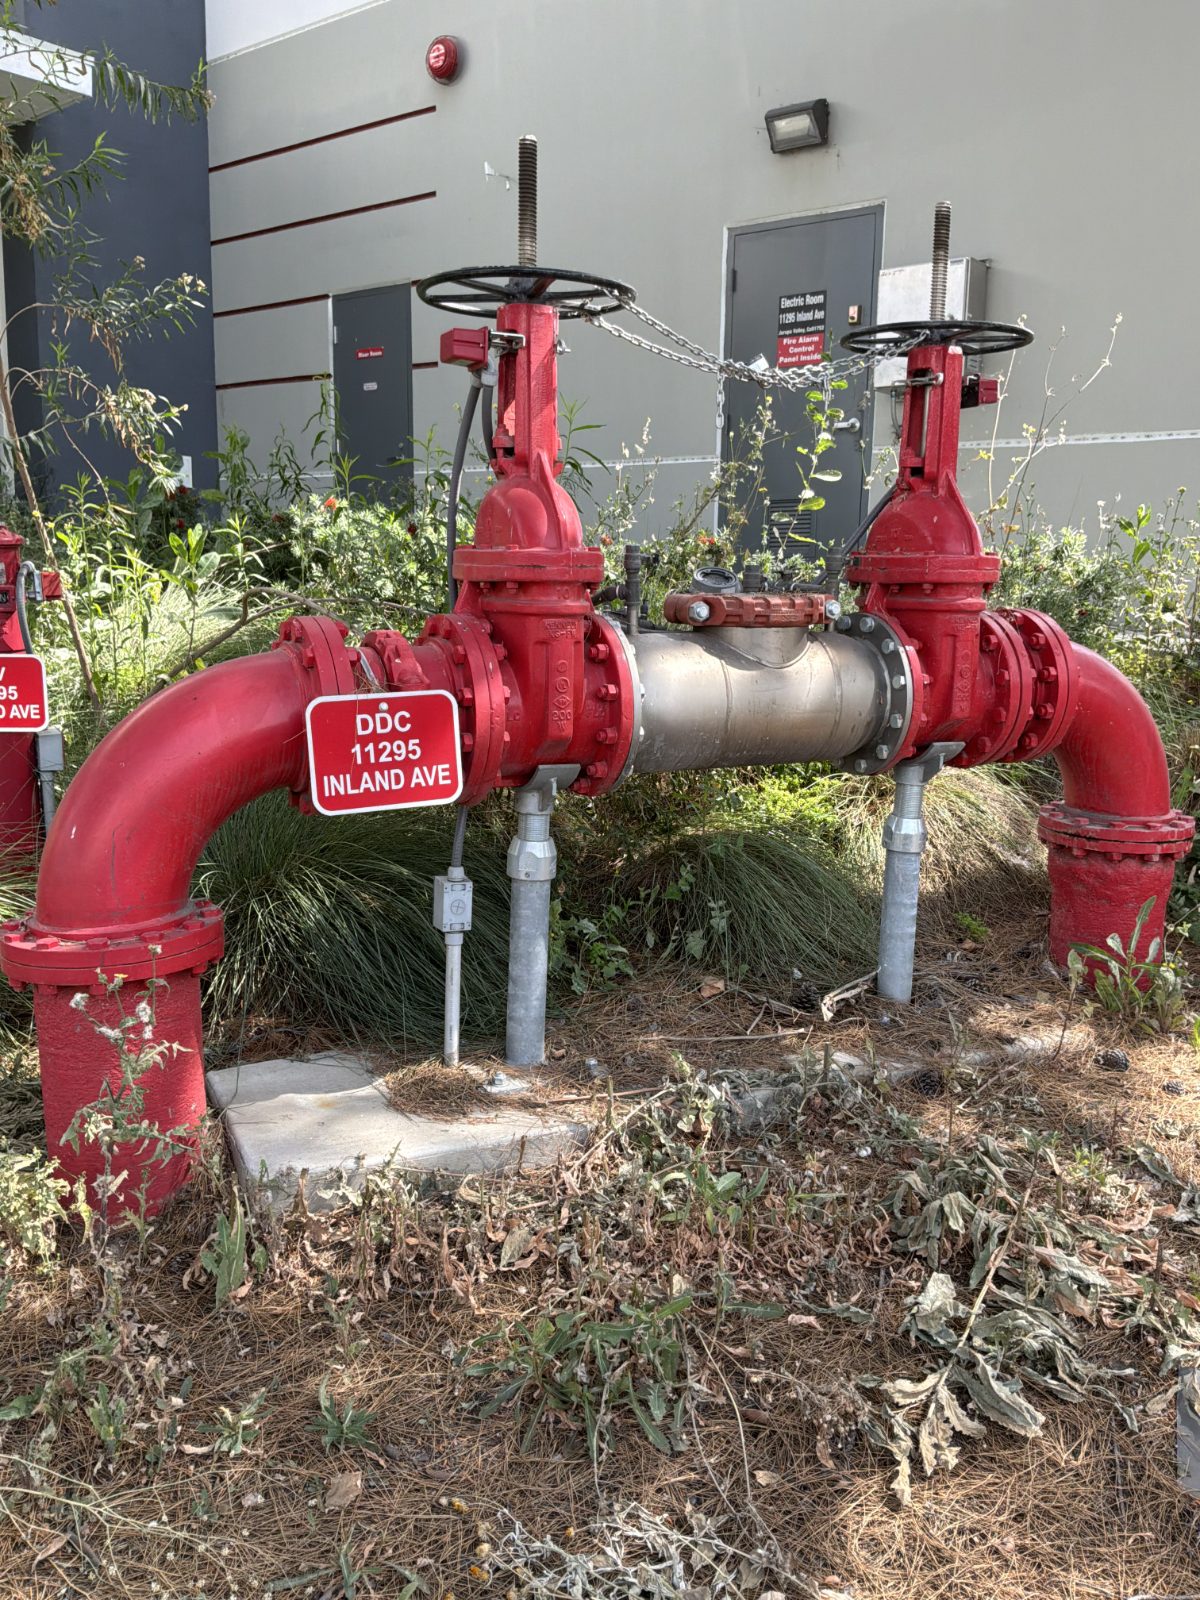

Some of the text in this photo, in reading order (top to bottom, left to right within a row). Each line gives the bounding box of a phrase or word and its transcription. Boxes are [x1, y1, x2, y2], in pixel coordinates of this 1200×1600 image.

[781, 295, 824, 308] Electric Room
[780, 308, 825, 324] 11295 Inland Ave
[783, 336, 819, 346] Fire Alarm
[789, 345, 814, 353] Control
[800, 353, 822, 361] Inside
[9, 704, 41, 719] AVE
[551, 710, 573, 721] 200
[356, 710, 412, 736] DDC
[351, 738, 422, 765] 11295
[323, 763, 452, 797] INLAND AVE
